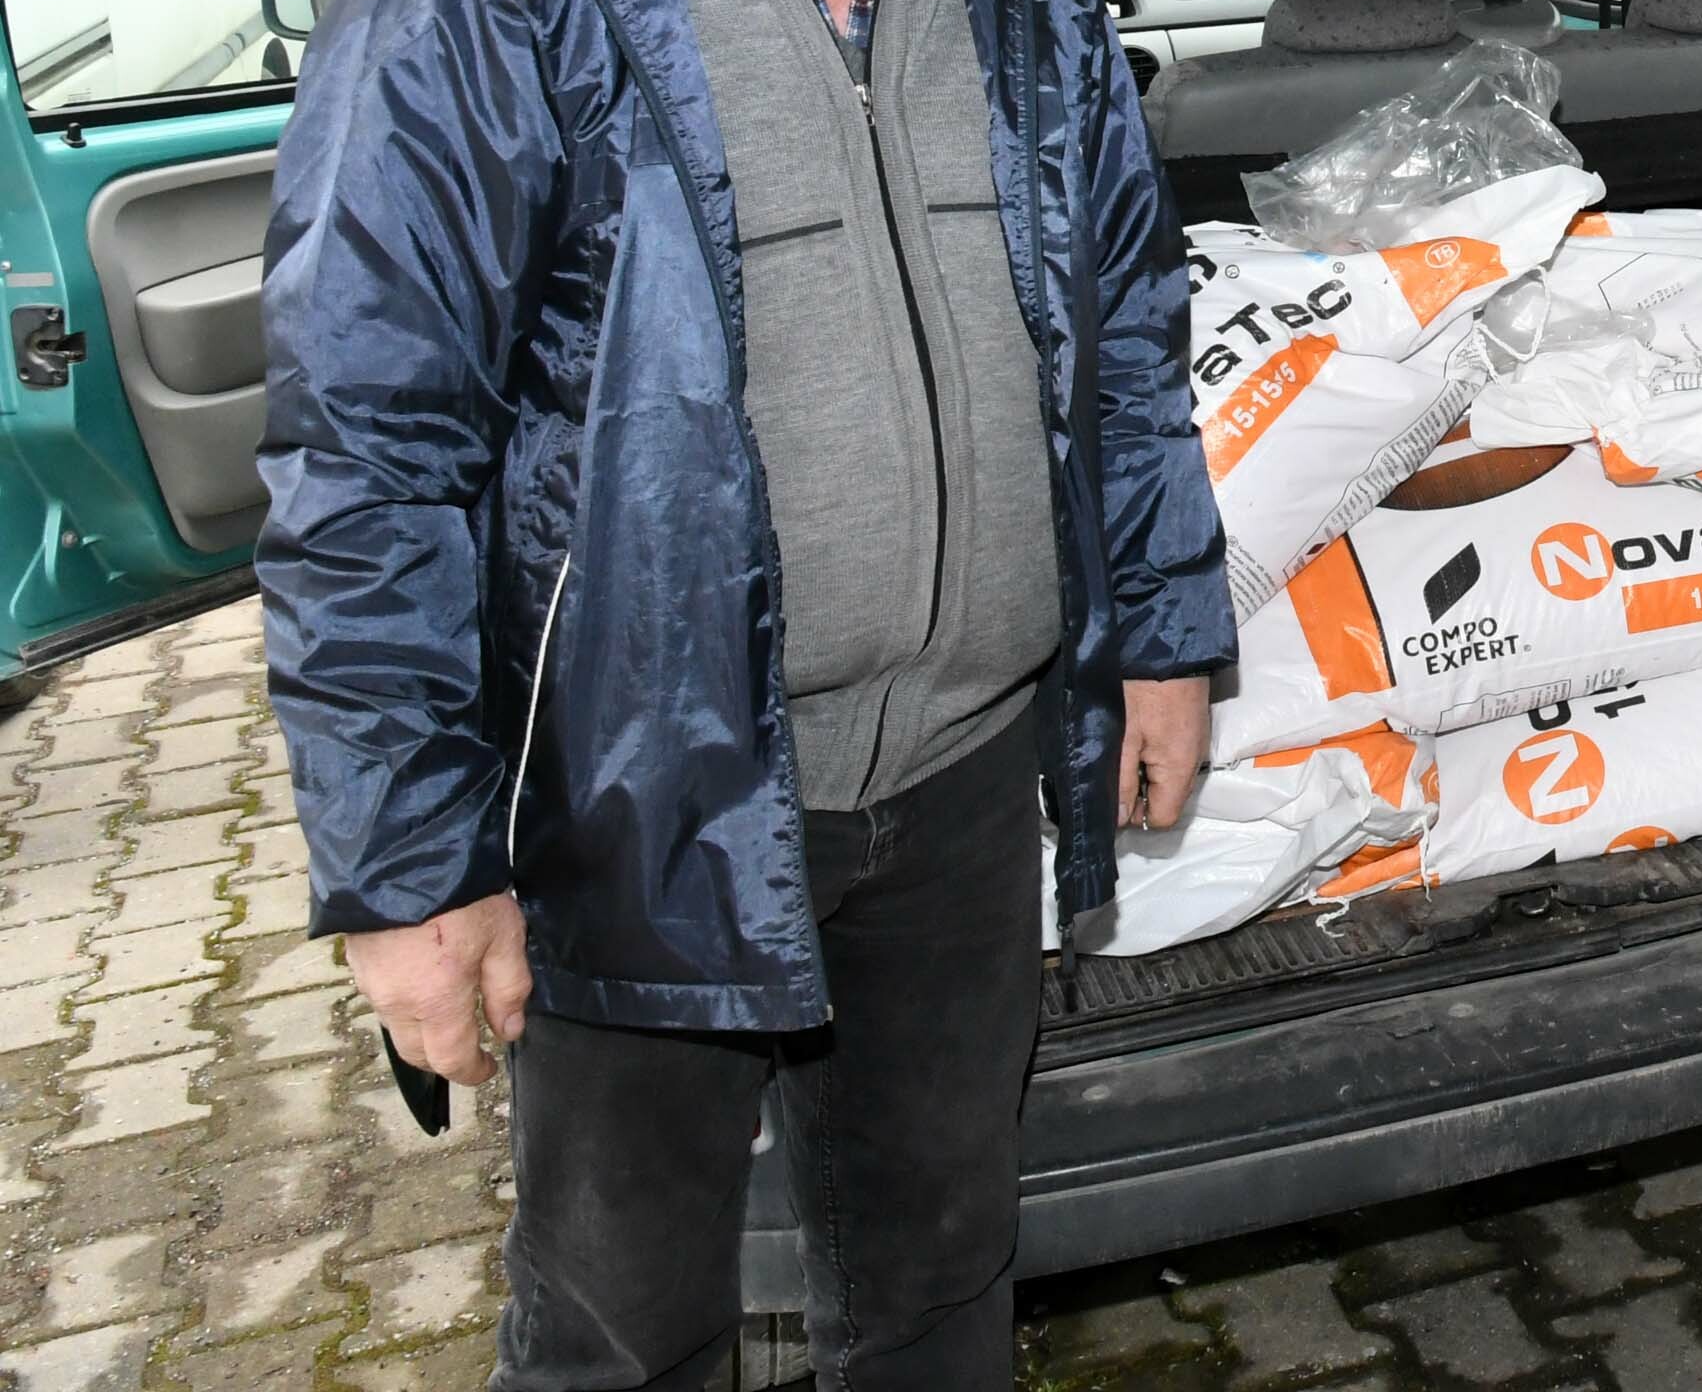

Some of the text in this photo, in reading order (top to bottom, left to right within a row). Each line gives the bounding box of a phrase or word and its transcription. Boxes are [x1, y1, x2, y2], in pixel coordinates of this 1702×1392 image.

[1192, 279, 1352, 387] aTec
[1402, 617, 1498, 657] COMPO
[1425, 634, 1520, 676] EXPERT
